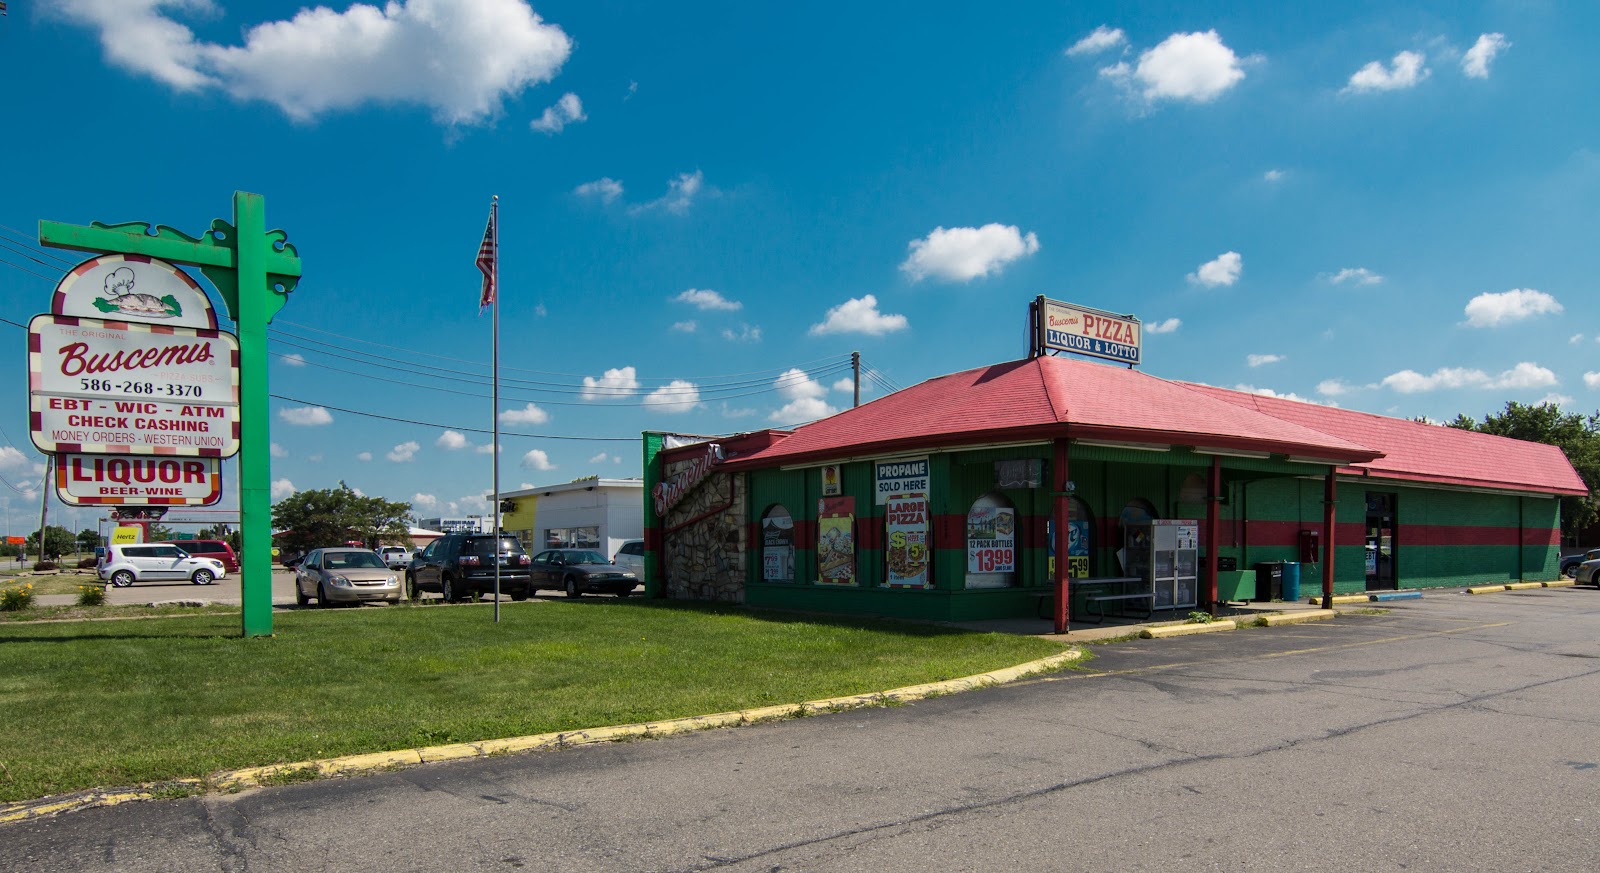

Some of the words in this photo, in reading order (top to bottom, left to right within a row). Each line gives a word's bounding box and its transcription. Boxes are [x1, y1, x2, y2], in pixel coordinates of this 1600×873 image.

[60, 328, 78, 336] THE
[81, 330, 126, 340] ORIGINAL
[1082, 314, 1135, 345] PIZZA
[1050, 330, 1091, 350] LIQUOR
[1095, 340, 1101, 352] &
[1105, 342, 1137, 359] LOTTO
[50, 398, 92, 411] EBT
[114, 402, 158, 414] WIC
[180, 406, 225, 418] ATM
[68, 415, 129, 429] CHECK
[134, 418, 210, 433] CASHING
[52, 430, 90, 442] MONEY
[92, 432, 136, 444] ORDERS
[144, 434, 192, 446] WESTERN
[194, 436, 224, 446] UNION
[72, 458, 206, 486] LIQUOR
[879, 462, 926, 478] PROPANE
[99, 487, 183, 496] BEER-WINE
[879, 480, 900, 492] SOLD
[903, 479, 926, 491] HERE
[888, 502, 924, 514] LARGE
[888, 512, 925, 526] PIZZA
[969, 540, 976, 548] 12
[976, 540, 990, 548] PACK
[991, 540, 1013, 548] BOTTLES
